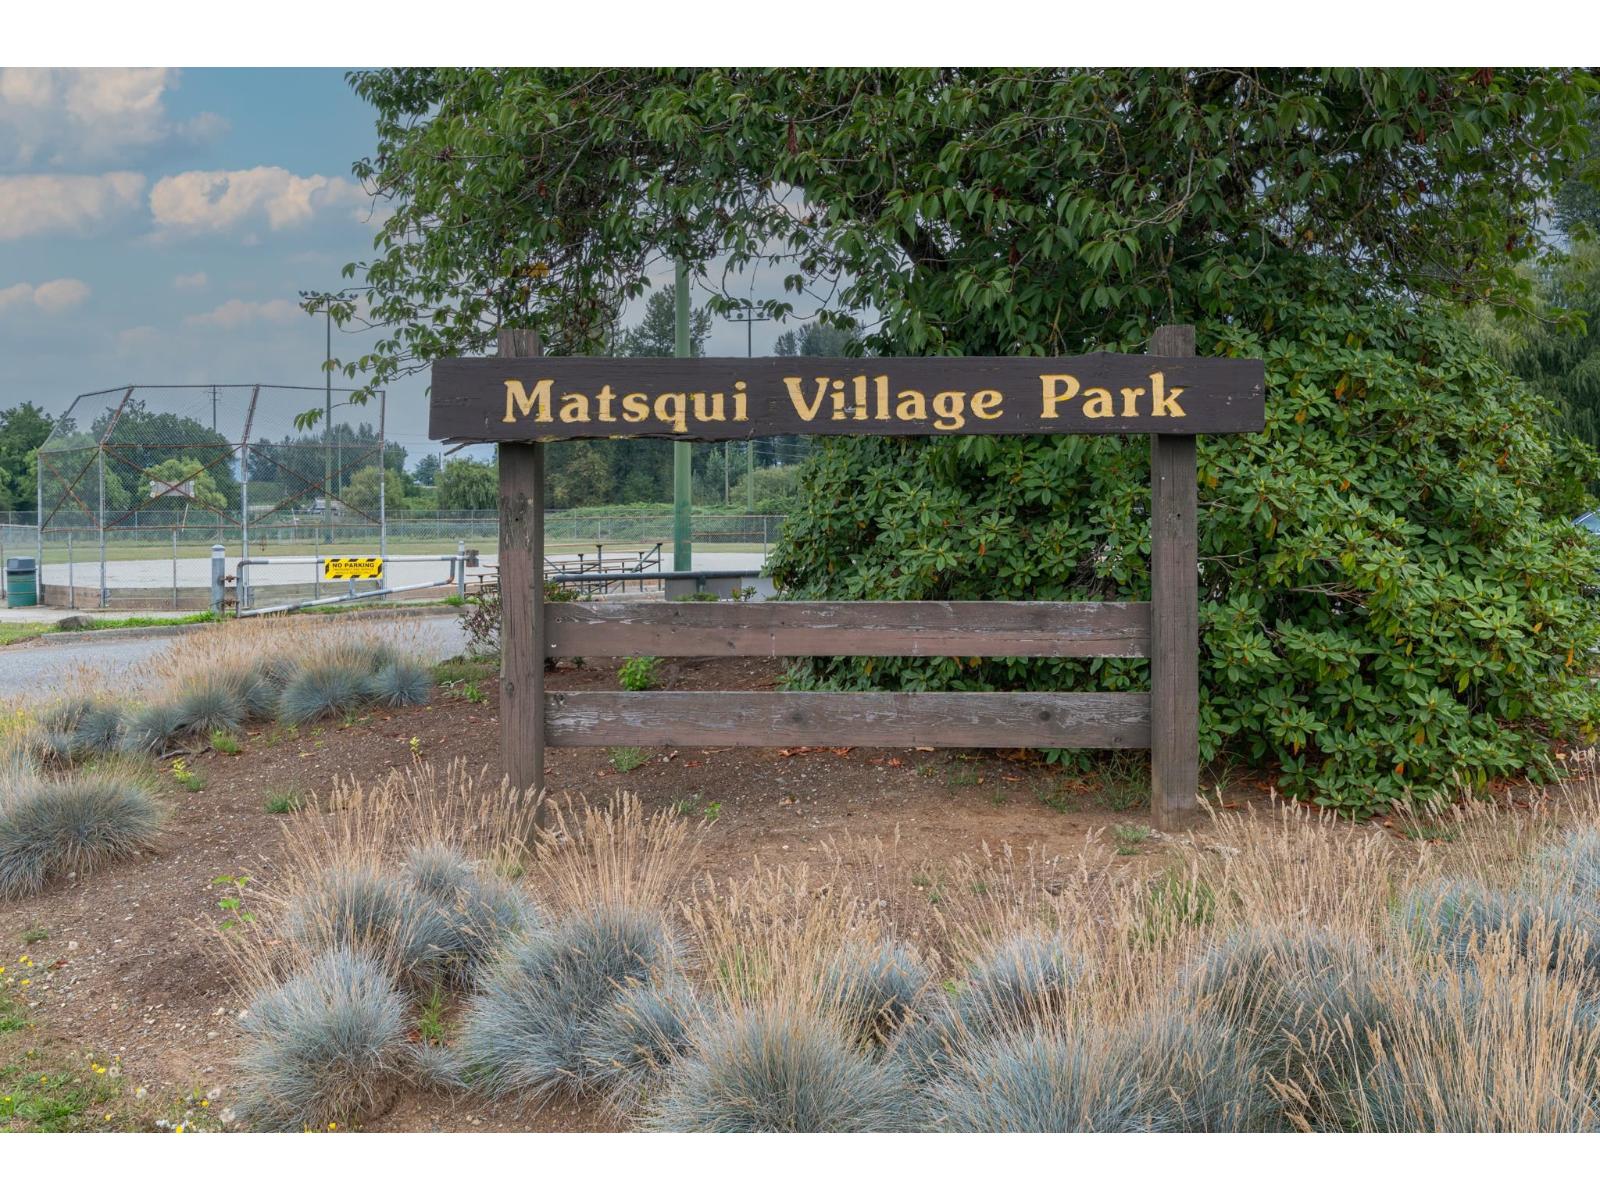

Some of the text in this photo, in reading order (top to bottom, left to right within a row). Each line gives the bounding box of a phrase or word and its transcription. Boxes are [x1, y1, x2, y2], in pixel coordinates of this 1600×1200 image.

[502, 371, 1187, 433] Matsqui Village Park
